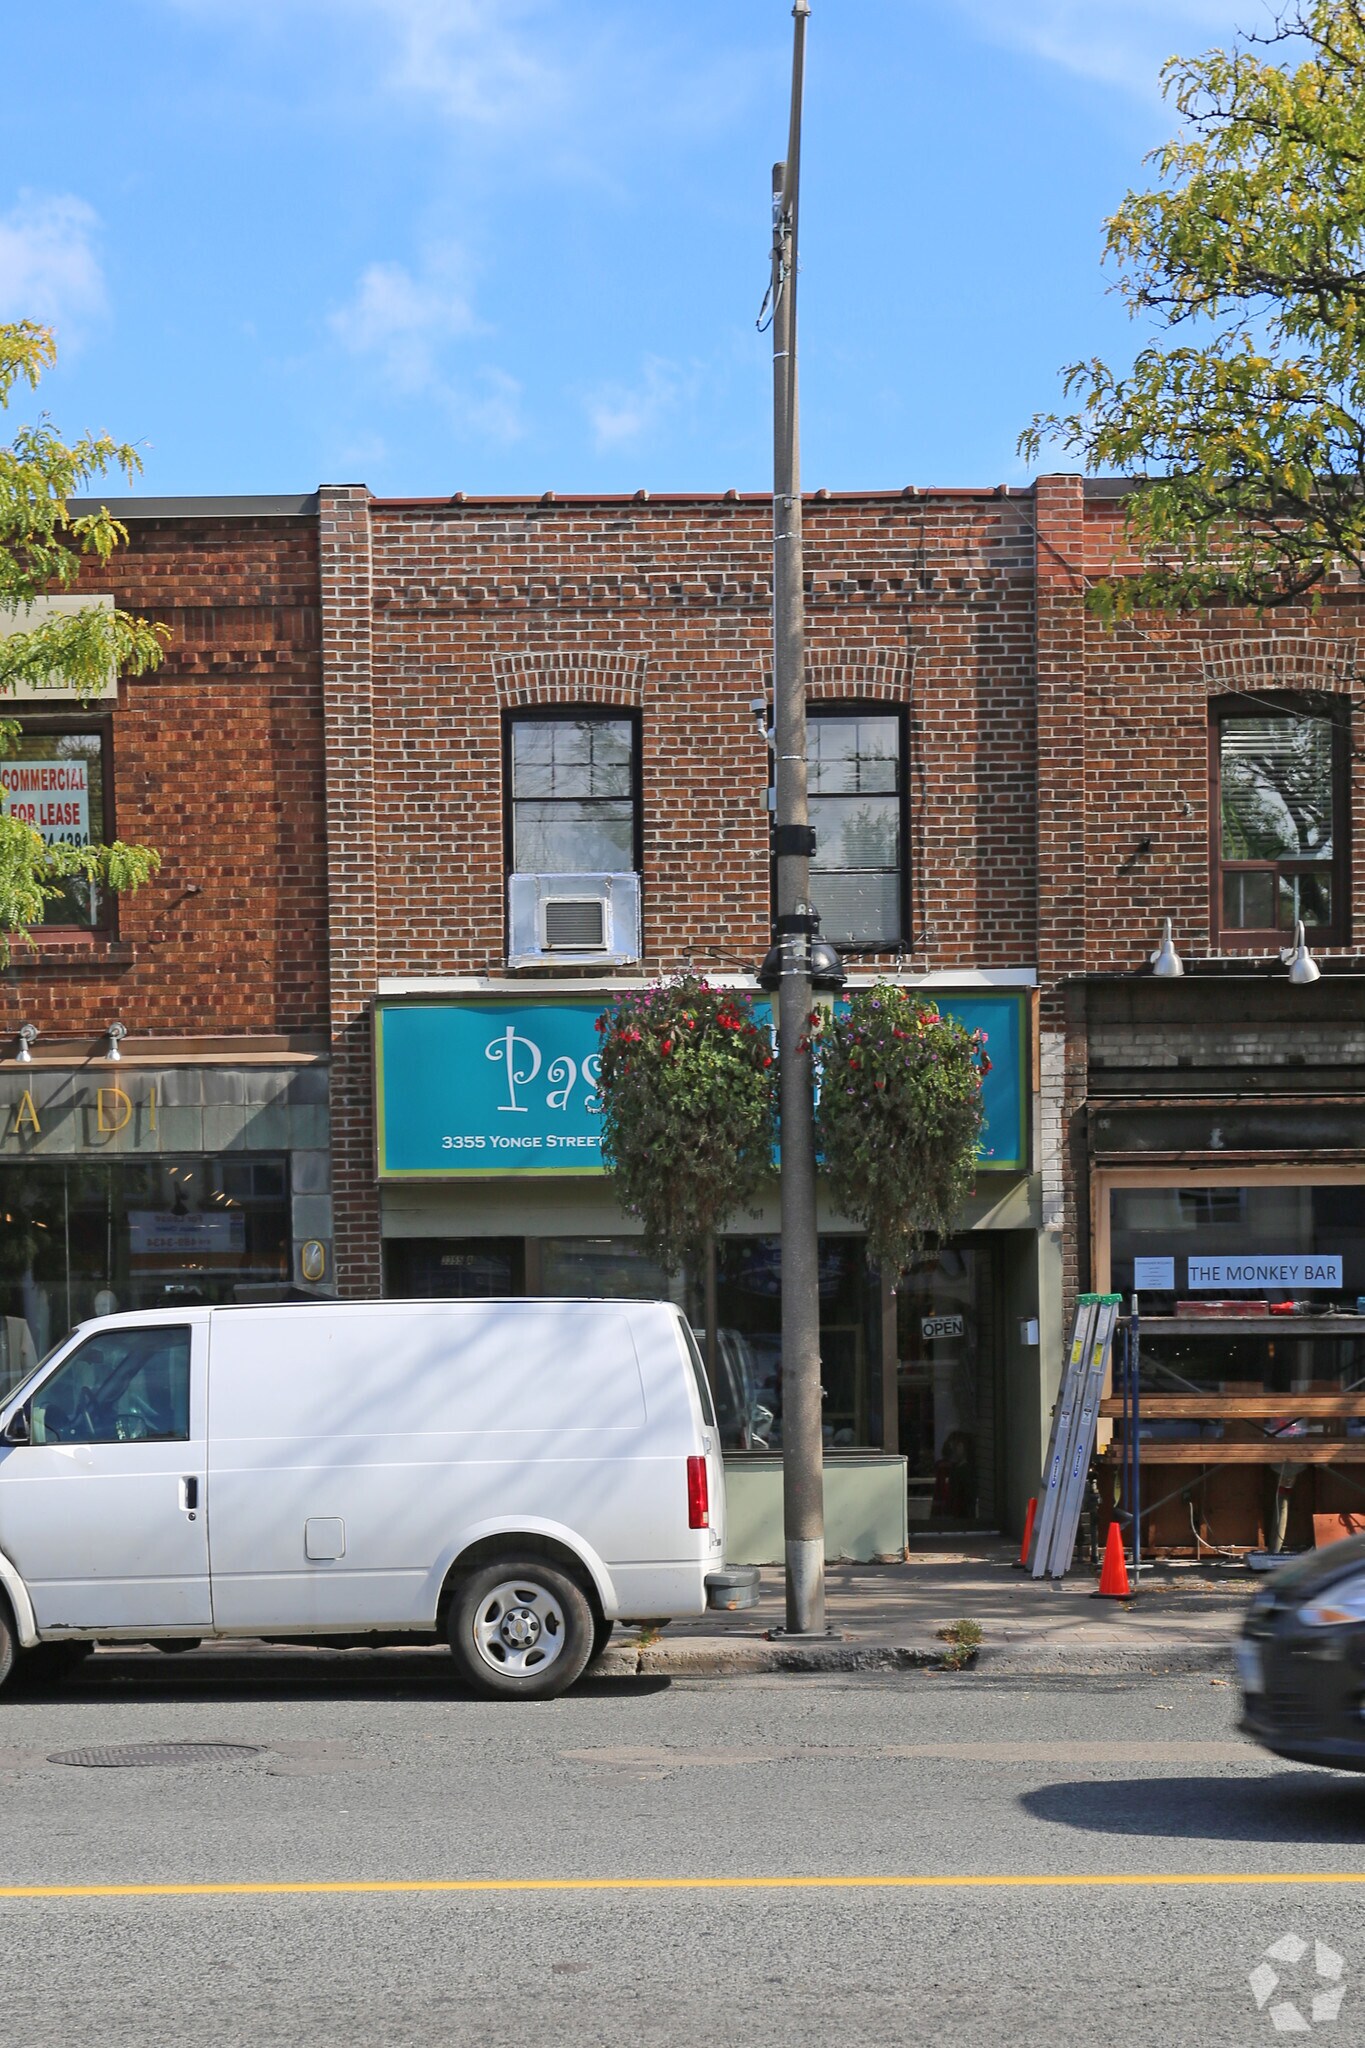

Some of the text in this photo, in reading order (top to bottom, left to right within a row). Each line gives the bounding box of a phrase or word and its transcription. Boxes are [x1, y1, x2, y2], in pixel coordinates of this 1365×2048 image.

[2, 768, 88, 791] COMMERCIAL
[10, 803, 80, 825] FOR LEASE
[485, 1026, 604, 1113] Pas
[442, 1135, 605, 1149] 3355 YONGE STREET
[1189, 1266, 1221, 1281] THE
[1226, 1265, 1299, 1281] MONKEY
[1304, 1265, 1337, 1280] BAR
[923, 1320, 962, 1337] OPEN
